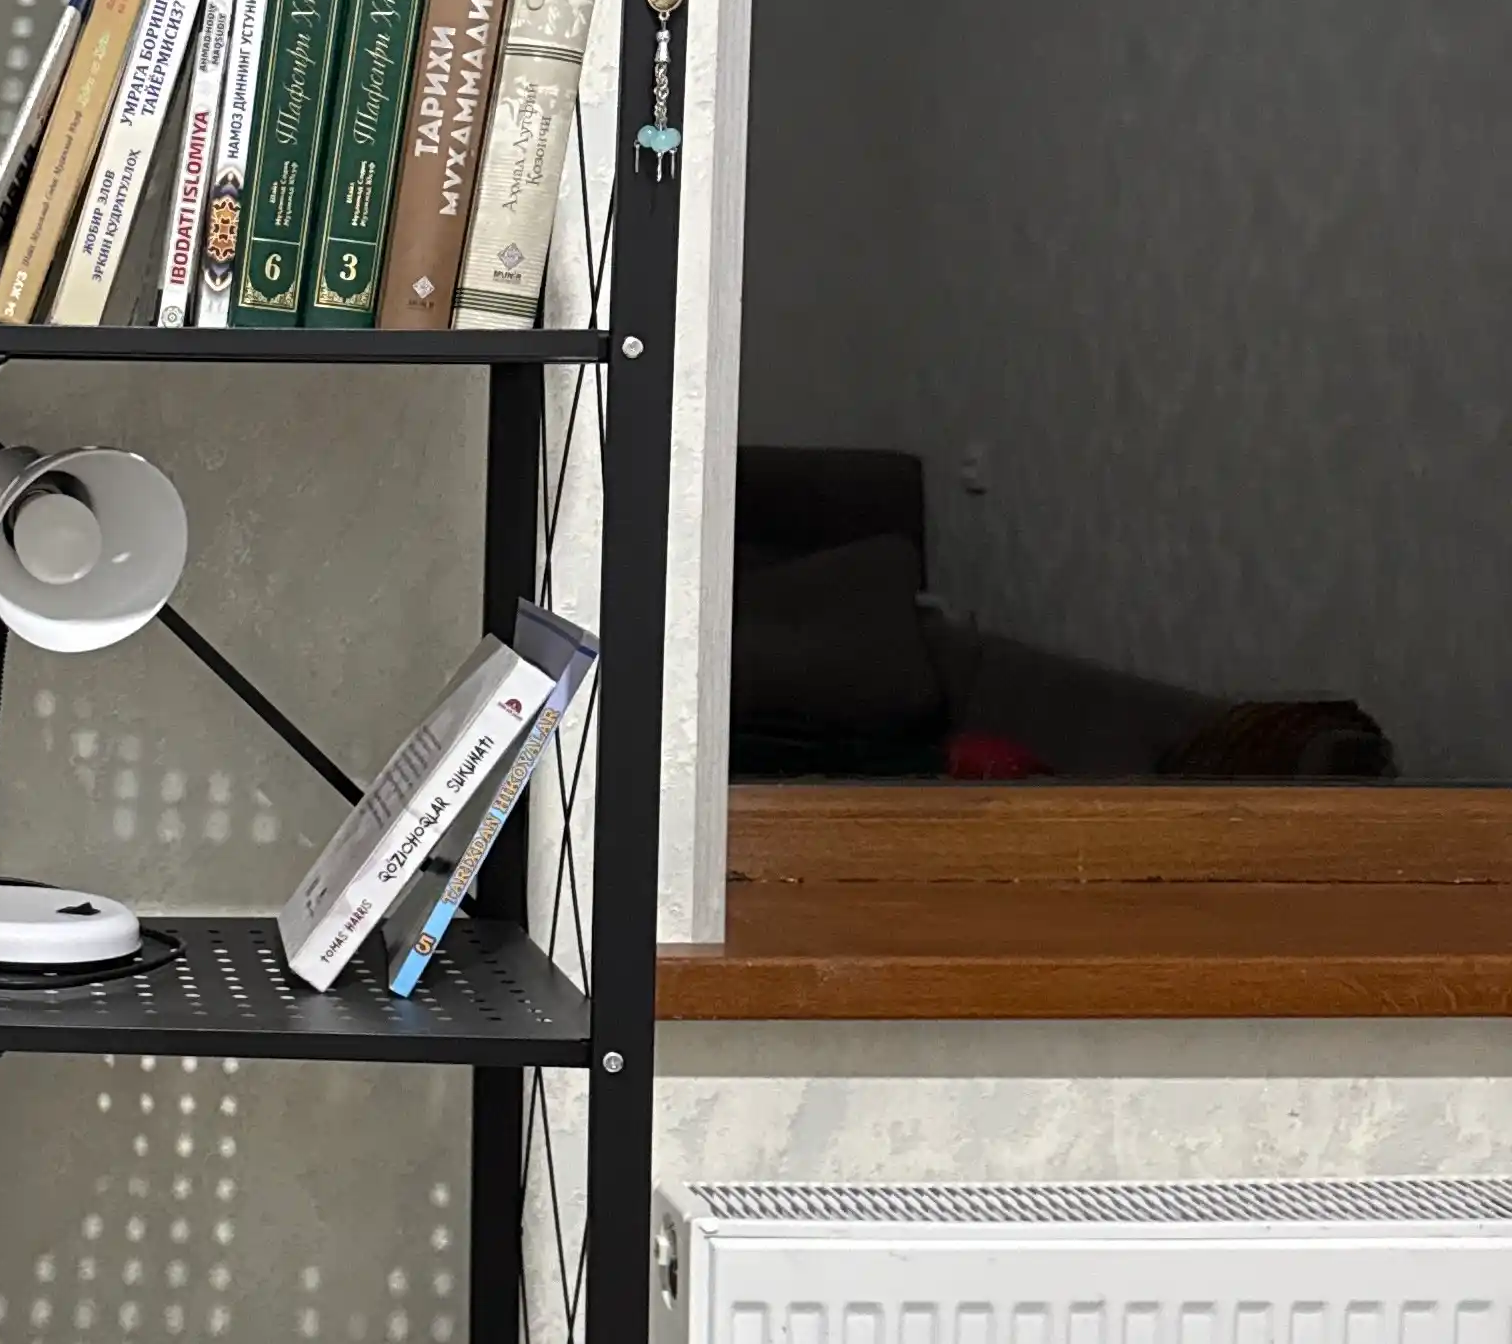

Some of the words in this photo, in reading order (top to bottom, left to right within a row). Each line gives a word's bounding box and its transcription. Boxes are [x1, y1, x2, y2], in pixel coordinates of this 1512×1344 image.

[198, 35, 211, 71] AHMAD
[210, 12, 227, 65] MAQSUDIY
[119, 63, 150, 127] УМРАГА
[233, 46, 252, 111] ДИННИНГ
[273, 31, 318, 146] Тафсири
[350, 31, 395, 147] Тафсири
[412, 24, 455, 159] ТАРИХИ
[181, 109, 211, 203] ISLOMIYA
[227, 112, 244, 159] НАМОЗ
[81, 206, 105, 255] ЖОБИР
[96, 169, 116, 205] ЭЛОВ
[91, 237, 114, 282] ЭРКИН
[169, 208, 195, 285] IBODATI
[263, 252, 283, 281] 6
[339, 252, 359, 281] 3
[9, 268, 28, 300] ЖУЗ
[445, 732, 496, 794] SUKUNATI
[438, 811, 502, 908] TARIXDAN
[489, 703, 560, 815] HIKOYALAR
[319, 930, 348, 965] TOMAS
[343, 897, 373, 932] HARRIS
[411, 930, 435, 957] 5
